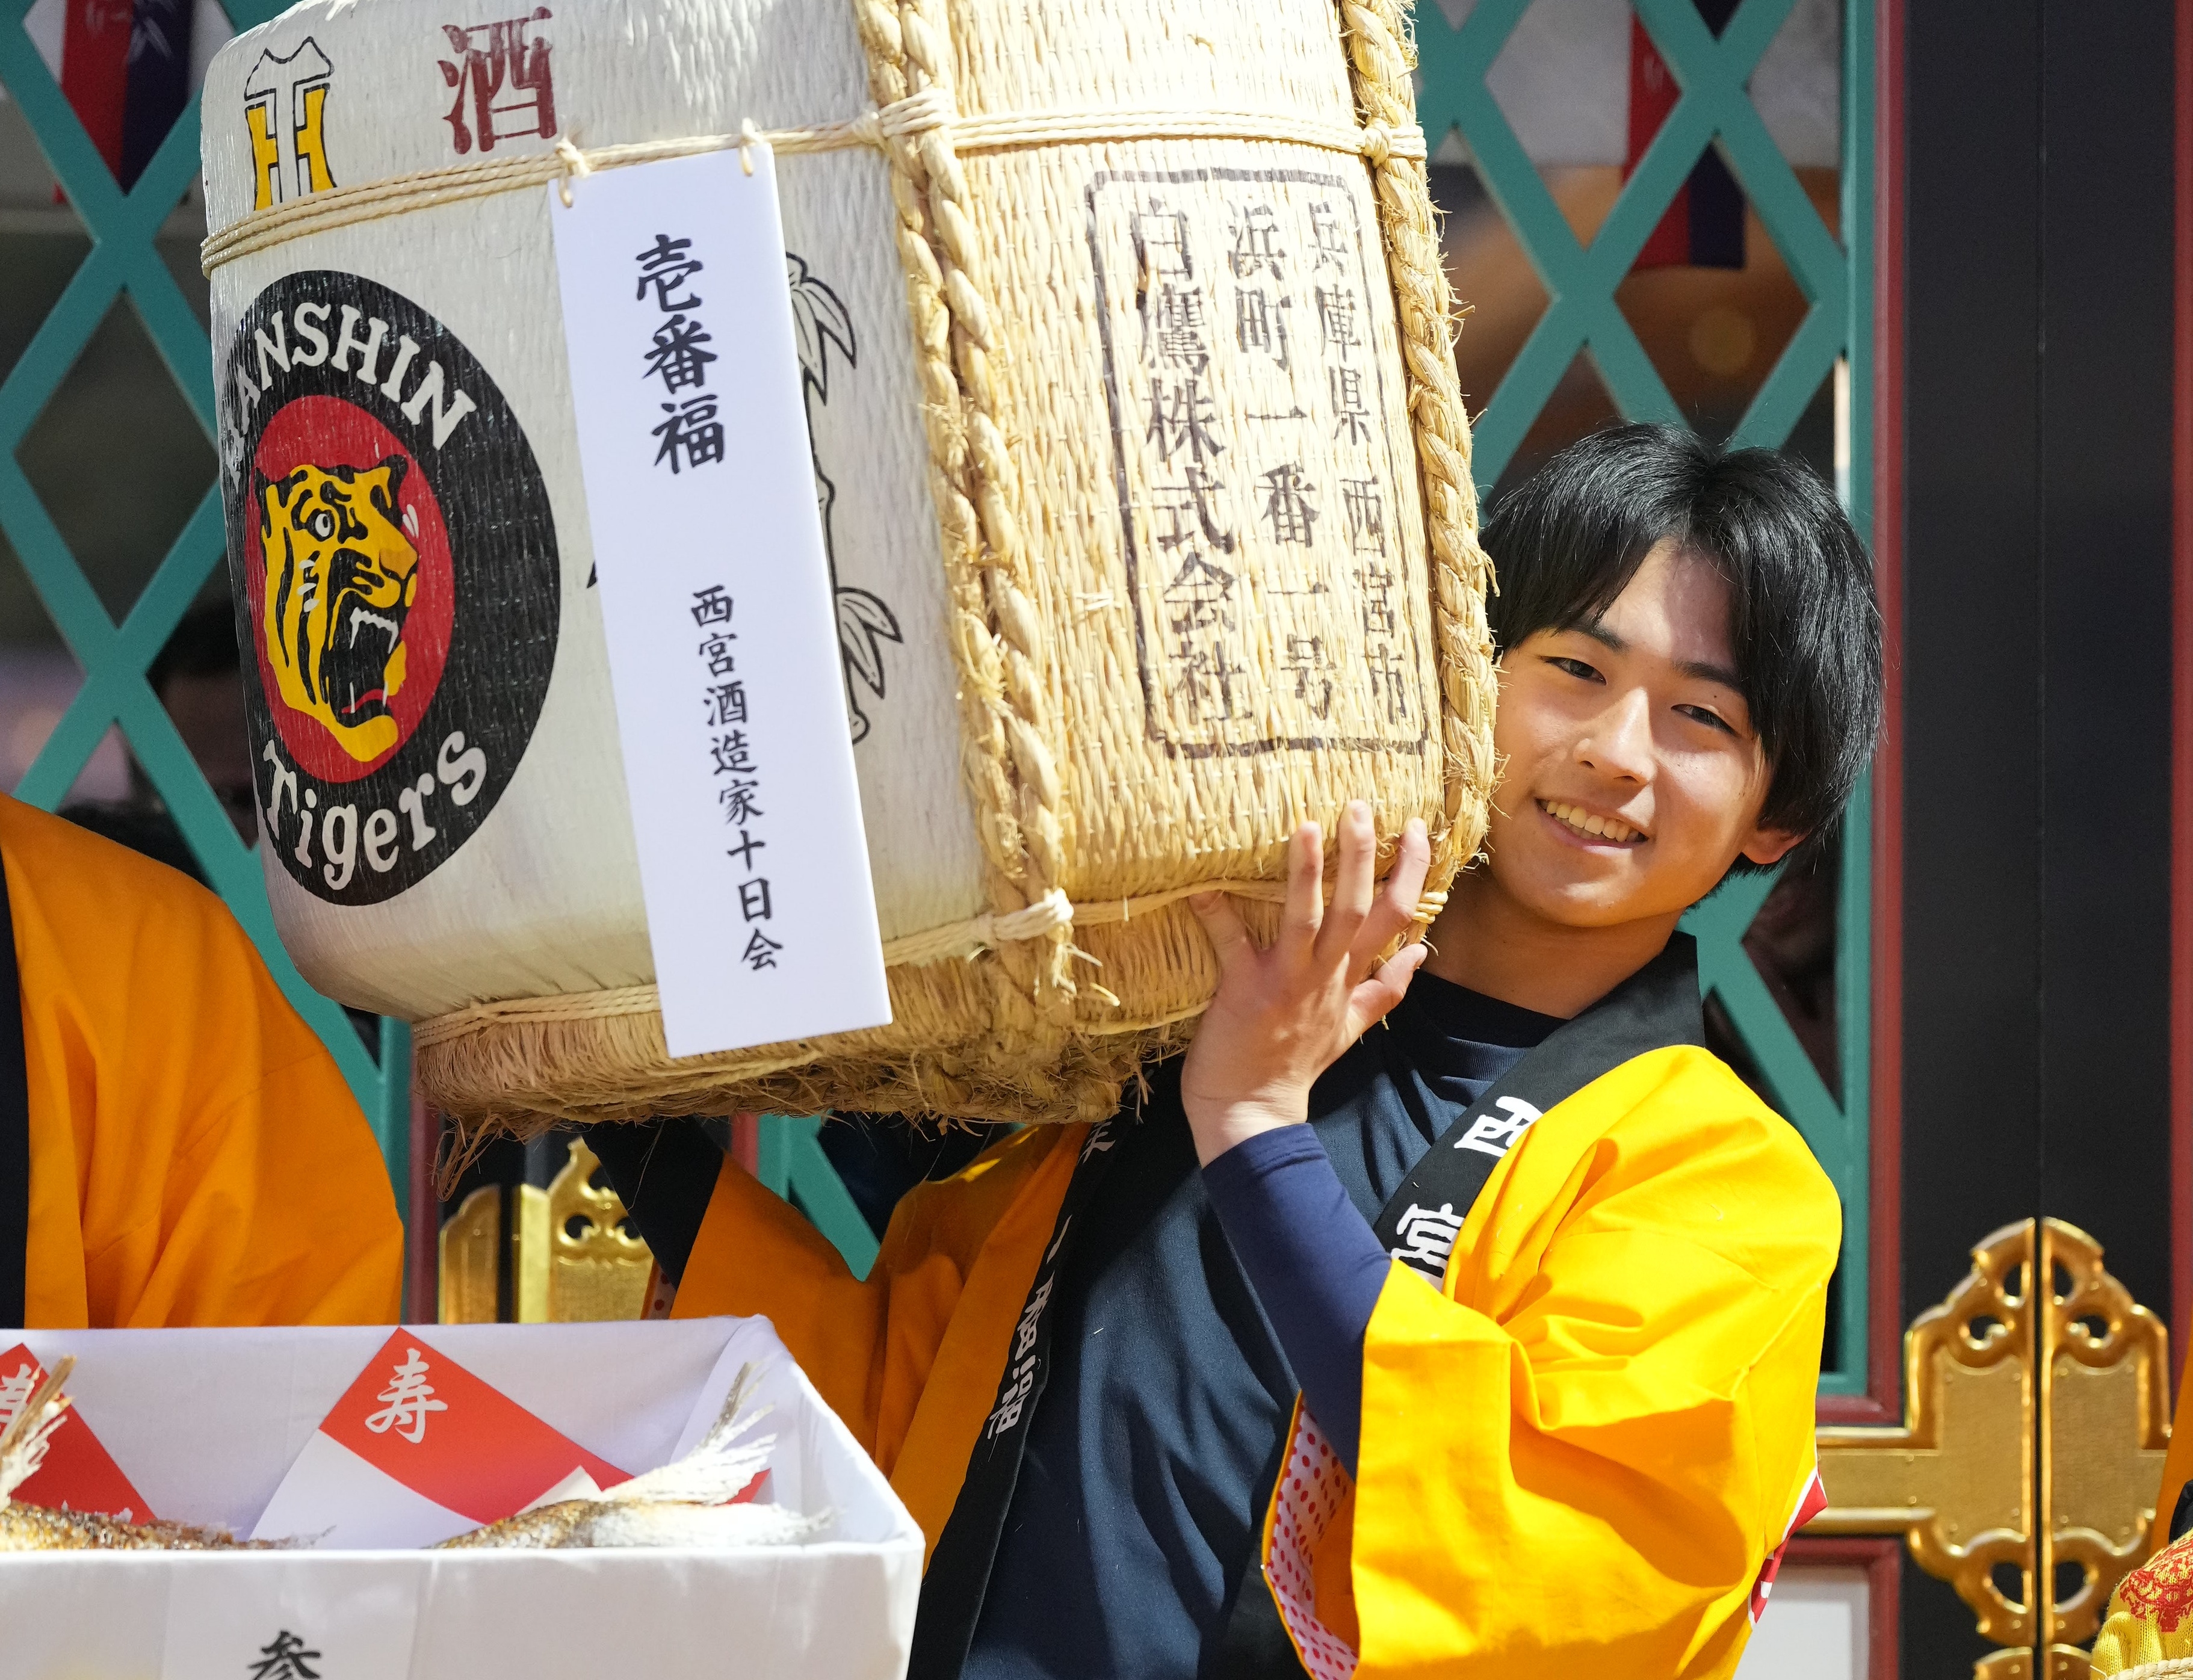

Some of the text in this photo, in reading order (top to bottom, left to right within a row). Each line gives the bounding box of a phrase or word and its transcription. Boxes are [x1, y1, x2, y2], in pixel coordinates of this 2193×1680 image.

[438, 7, 557, 154] 酒
[634, 235, 726, 473] 壱番福
[1308, 202, 1372, 446] 兵庫県
[1129, 197, 1252, 723] 白鷹株式会社
[1228, 203, 1334, 723] 浜町一番一号
[264, 729, 489, 890] Tigers
[690, 584, 784, 971] 西宮酒造家十日会
[365, 1348, 448, 1444] 寿
